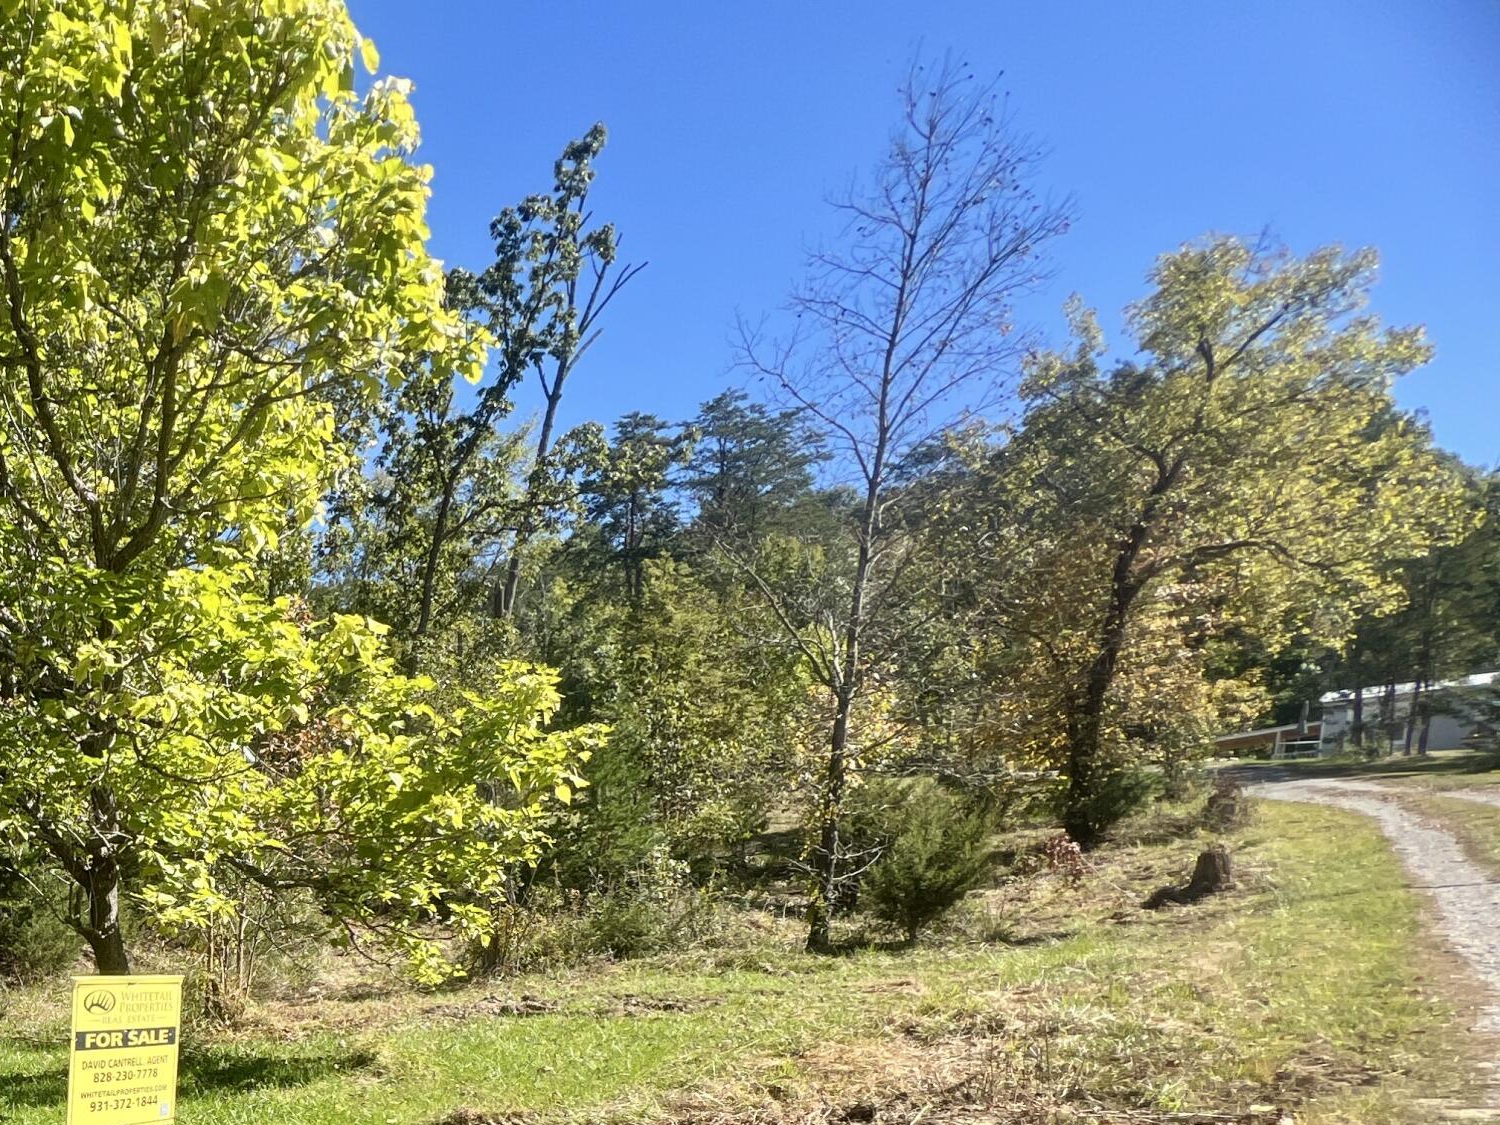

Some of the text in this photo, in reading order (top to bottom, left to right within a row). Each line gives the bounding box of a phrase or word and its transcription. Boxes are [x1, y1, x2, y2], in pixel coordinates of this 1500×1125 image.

[121, 991, 172, 1001] WHITETAIL
[119, 1002, 173, 1013] PROPERTIES
[102, 1014, 156, 1024] REAL ESTATE
[85, 1029, 169, 1048] FOR SALE
[82, 1058, 106, 1070] DAVID
[147, 1055, 169, 1065] AGENT
[93, 1069, 158, 1083] 828-230-7778
[90, 1095, 158, 1112] 931-372-1844
